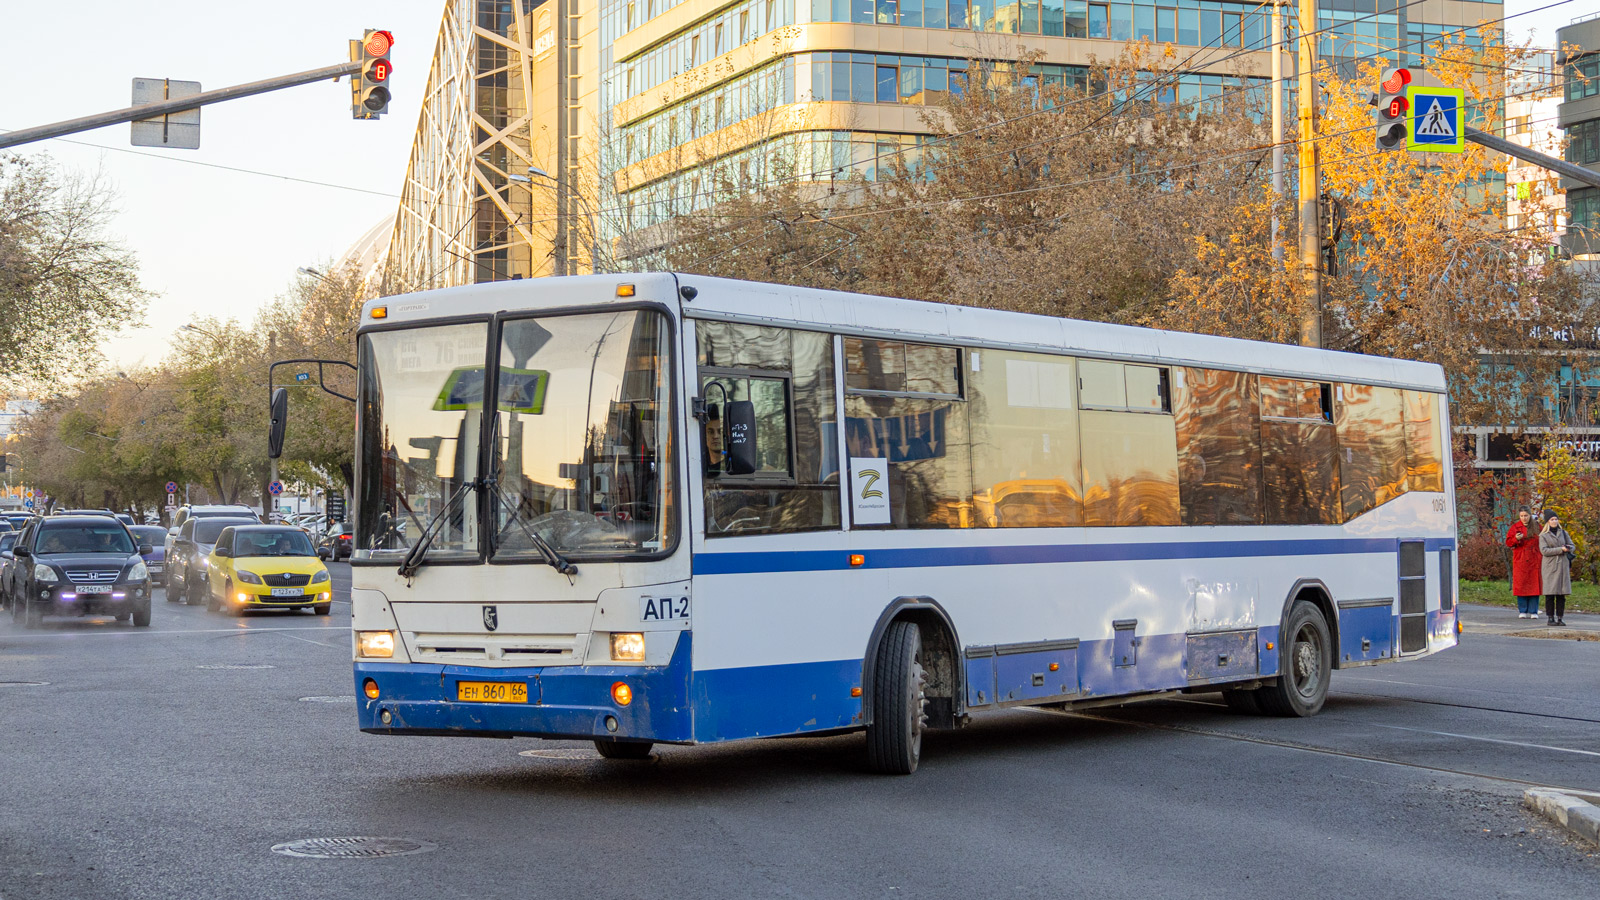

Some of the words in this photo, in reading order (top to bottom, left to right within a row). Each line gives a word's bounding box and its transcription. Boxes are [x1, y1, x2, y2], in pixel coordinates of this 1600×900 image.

[377, 65, 386, 80] 8
[1390, 102, 1399, 116] 8
[434, 340, 454, 364] 76
[858, 468, 884, 500] Z
[643, 596, 690, 621] АП-2
[483, 684, 506, 699] 860
[512, 684, 524, 696] 66
